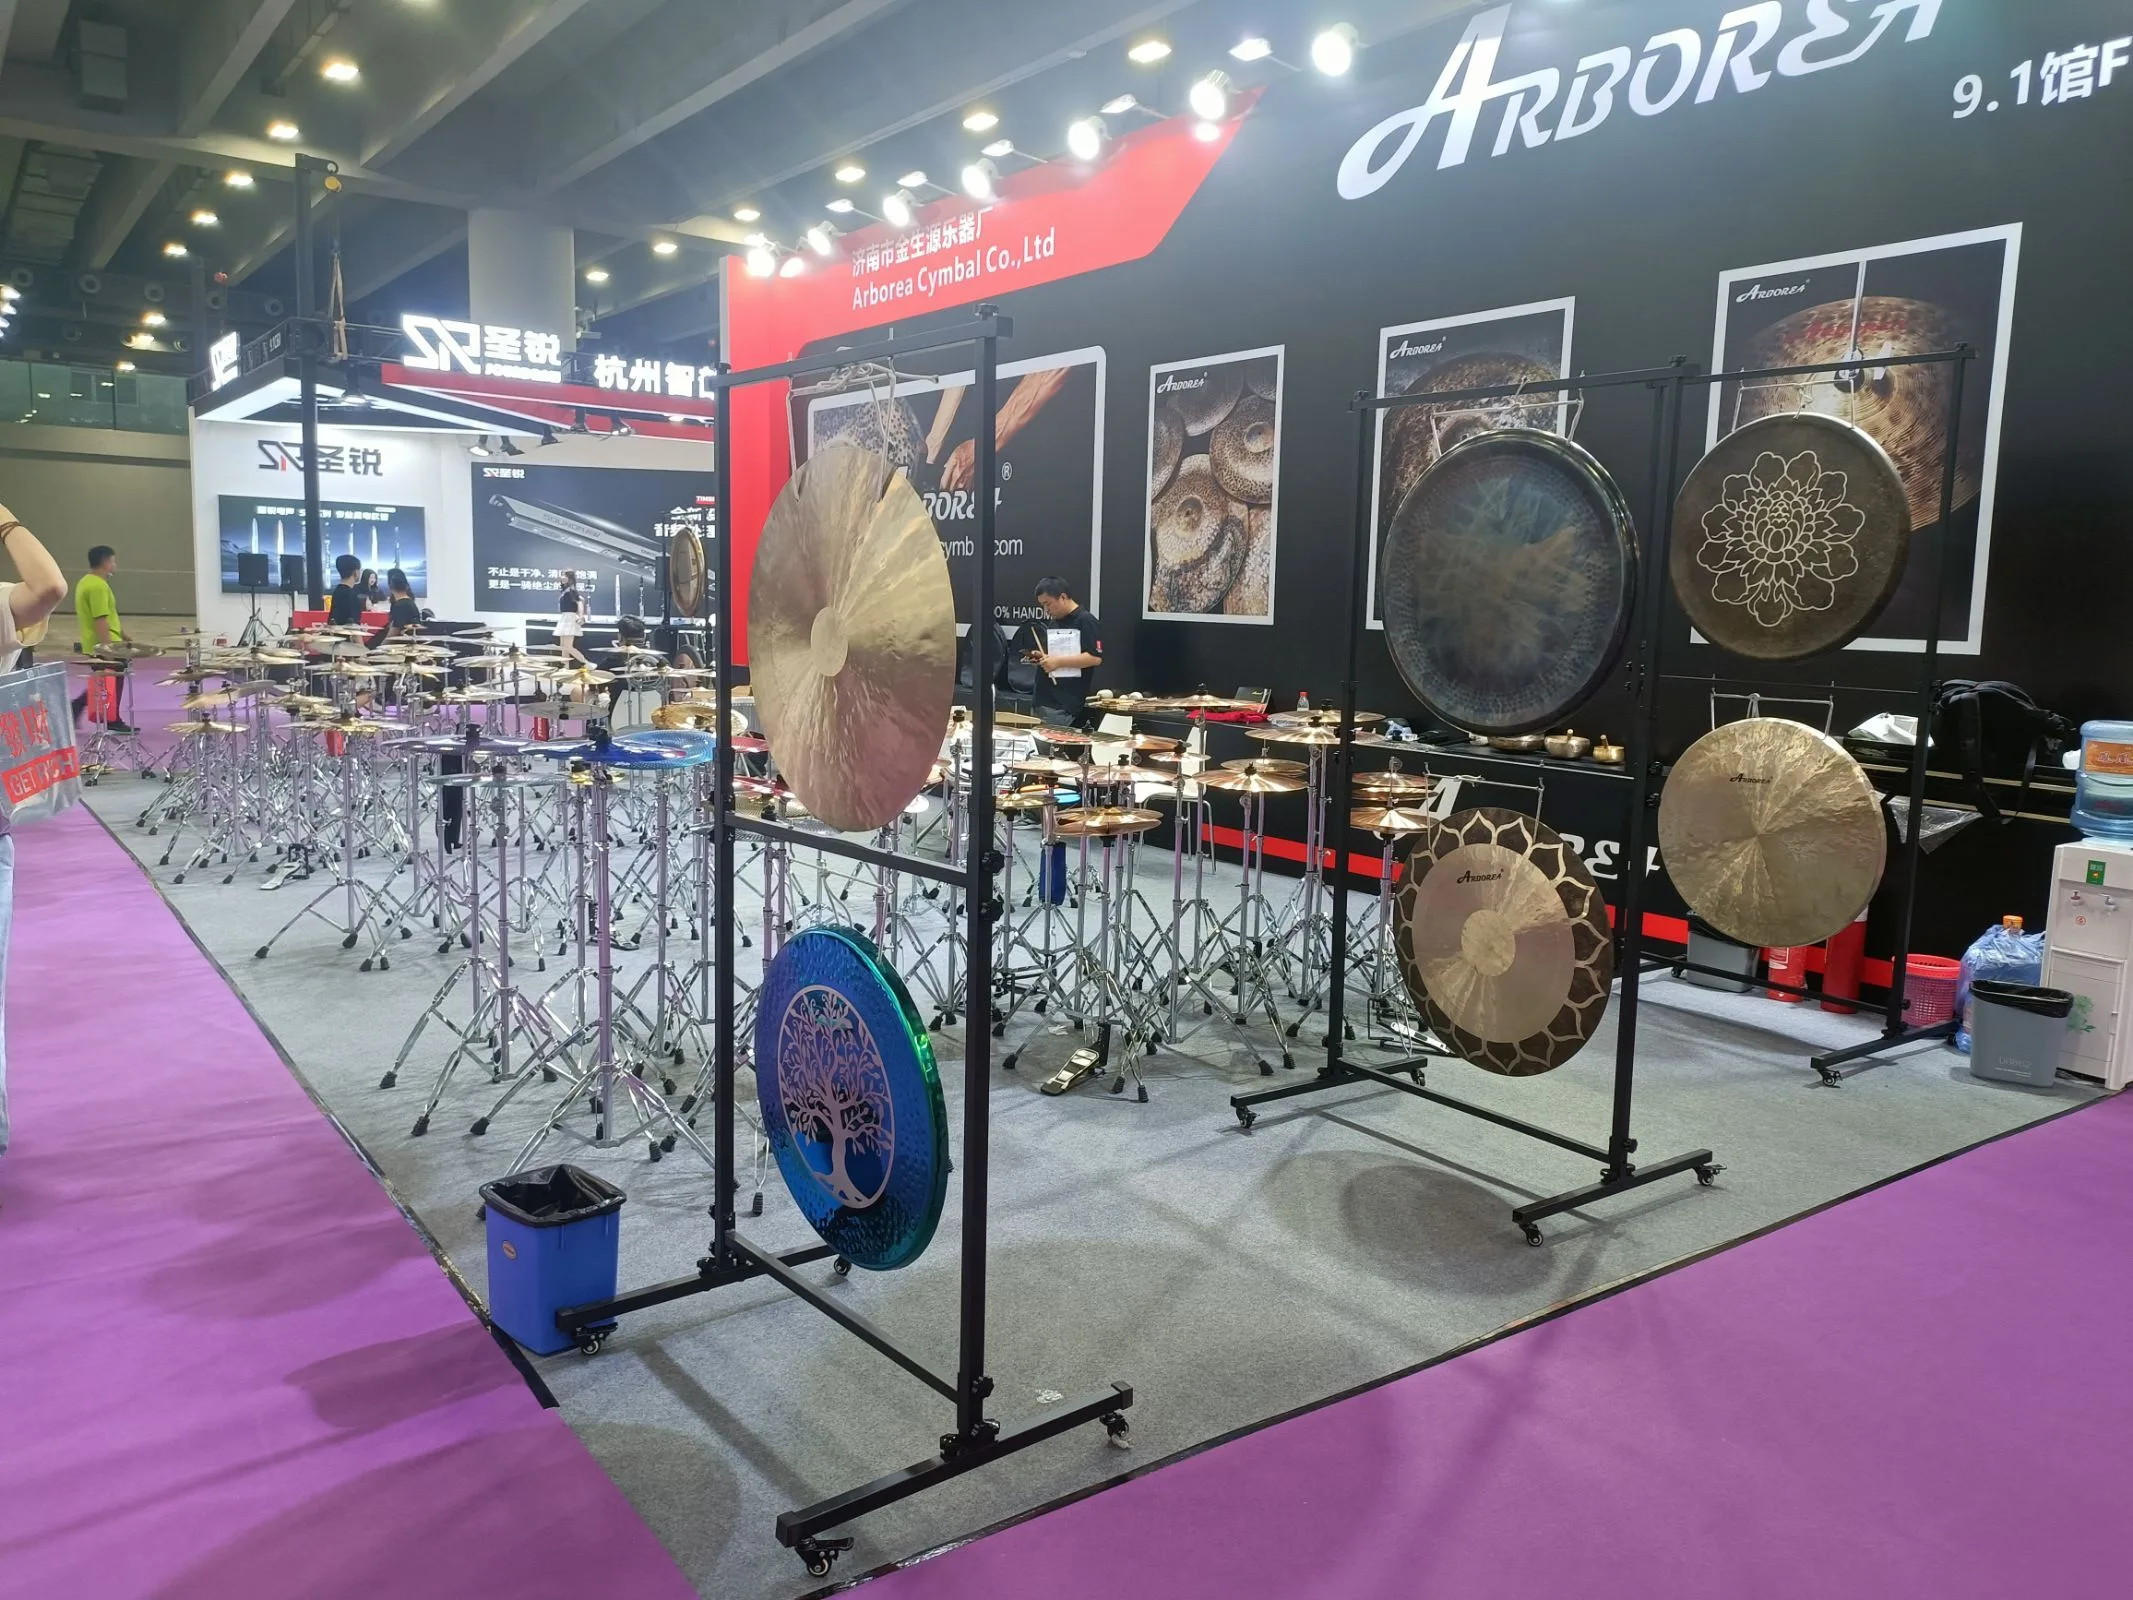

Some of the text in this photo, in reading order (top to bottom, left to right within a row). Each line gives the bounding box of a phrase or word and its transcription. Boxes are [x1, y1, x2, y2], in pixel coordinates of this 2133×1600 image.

[852, 206, 993, 277] 济南市金生源乐器厂
[852, 226, 1055, 310] Arborea Cymbal Co.,Ltd
[1736, 284, 1805, 303] ARBOREA
[484, 325, 562, 366] 圣锐
[1390, 340, 1442, 360] ARBOREA
[1157, 375, 1204, 394] ARBOREA
[316, 445, 383, 477] 圣锐
[9, 764, 38, 797] GET
